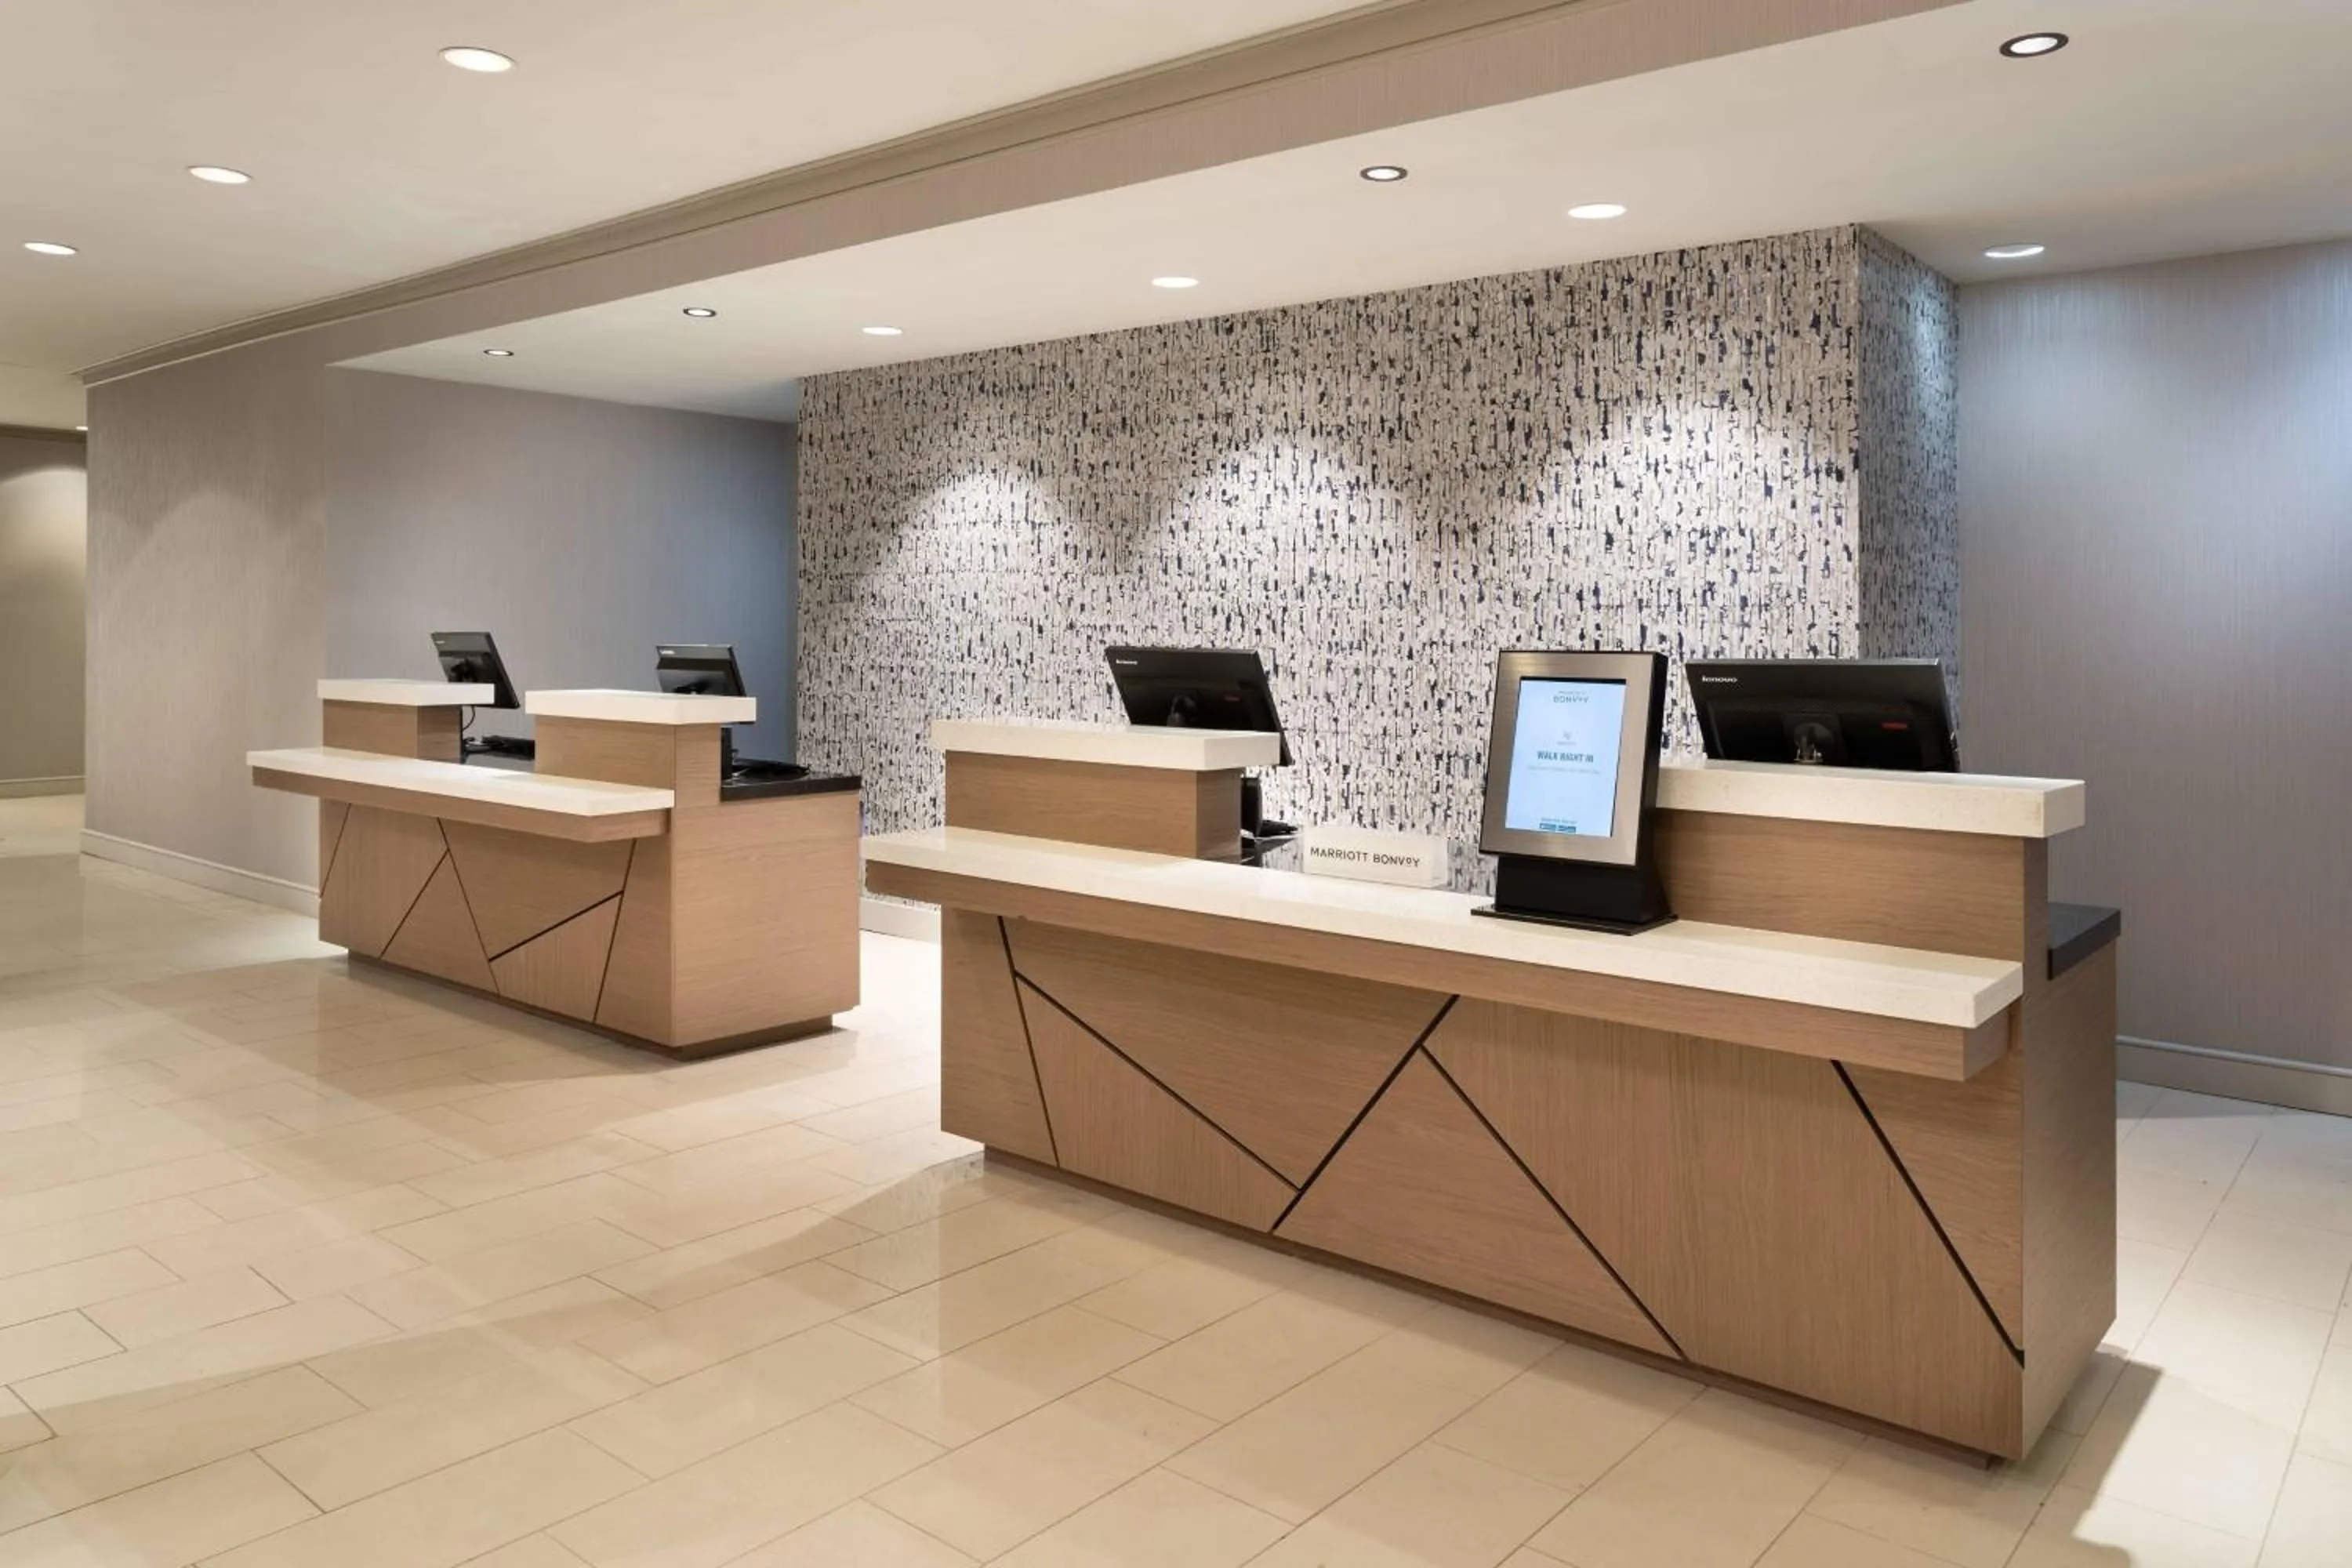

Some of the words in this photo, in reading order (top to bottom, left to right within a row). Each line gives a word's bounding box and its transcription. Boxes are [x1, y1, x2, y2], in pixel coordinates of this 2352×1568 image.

[1537, 751, 1558, 760] WALK
[1560, 752, 1583, 762] RIGHT
[1585, 754, 1594, 763] IN
[1310, 847, 1368, 862] MARRIOTT
